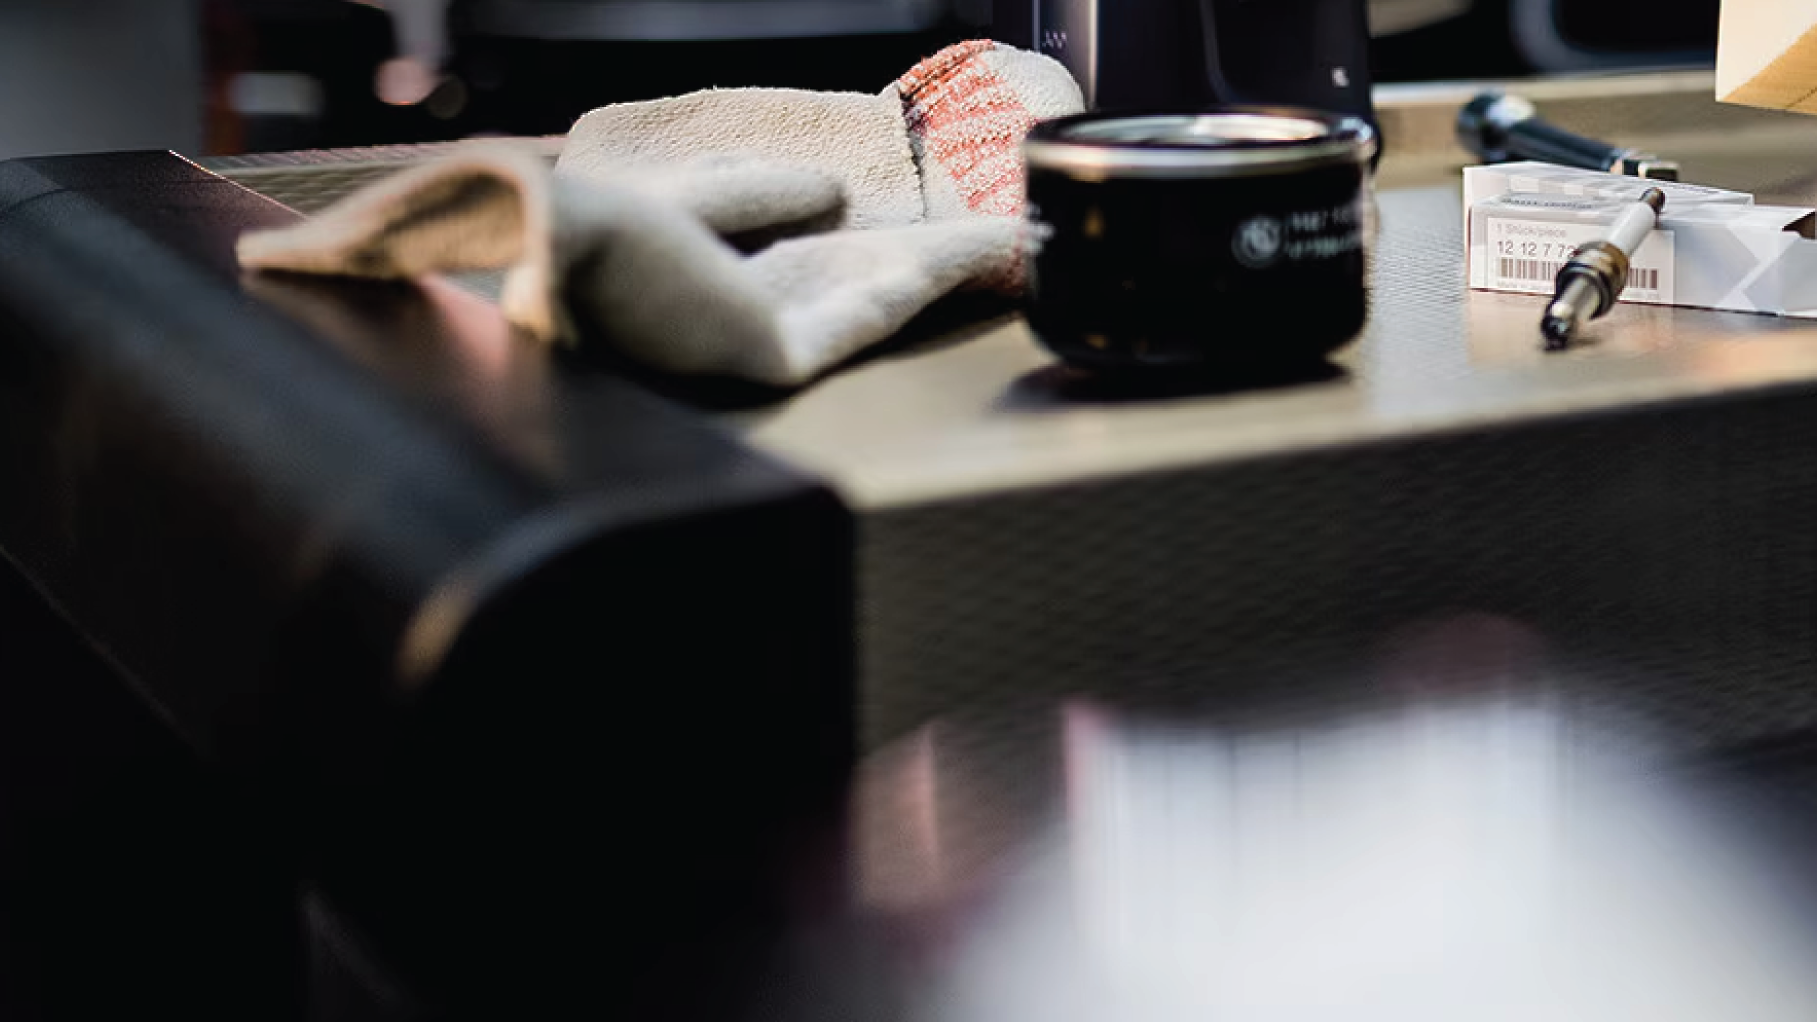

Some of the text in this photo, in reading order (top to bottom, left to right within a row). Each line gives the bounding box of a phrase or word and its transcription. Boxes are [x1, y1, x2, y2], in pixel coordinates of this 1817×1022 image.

[1498, 240, 1514, 255] 12
[1521, 241, 1537, 256] 12
[1543, 242, 1552, 257] 7
